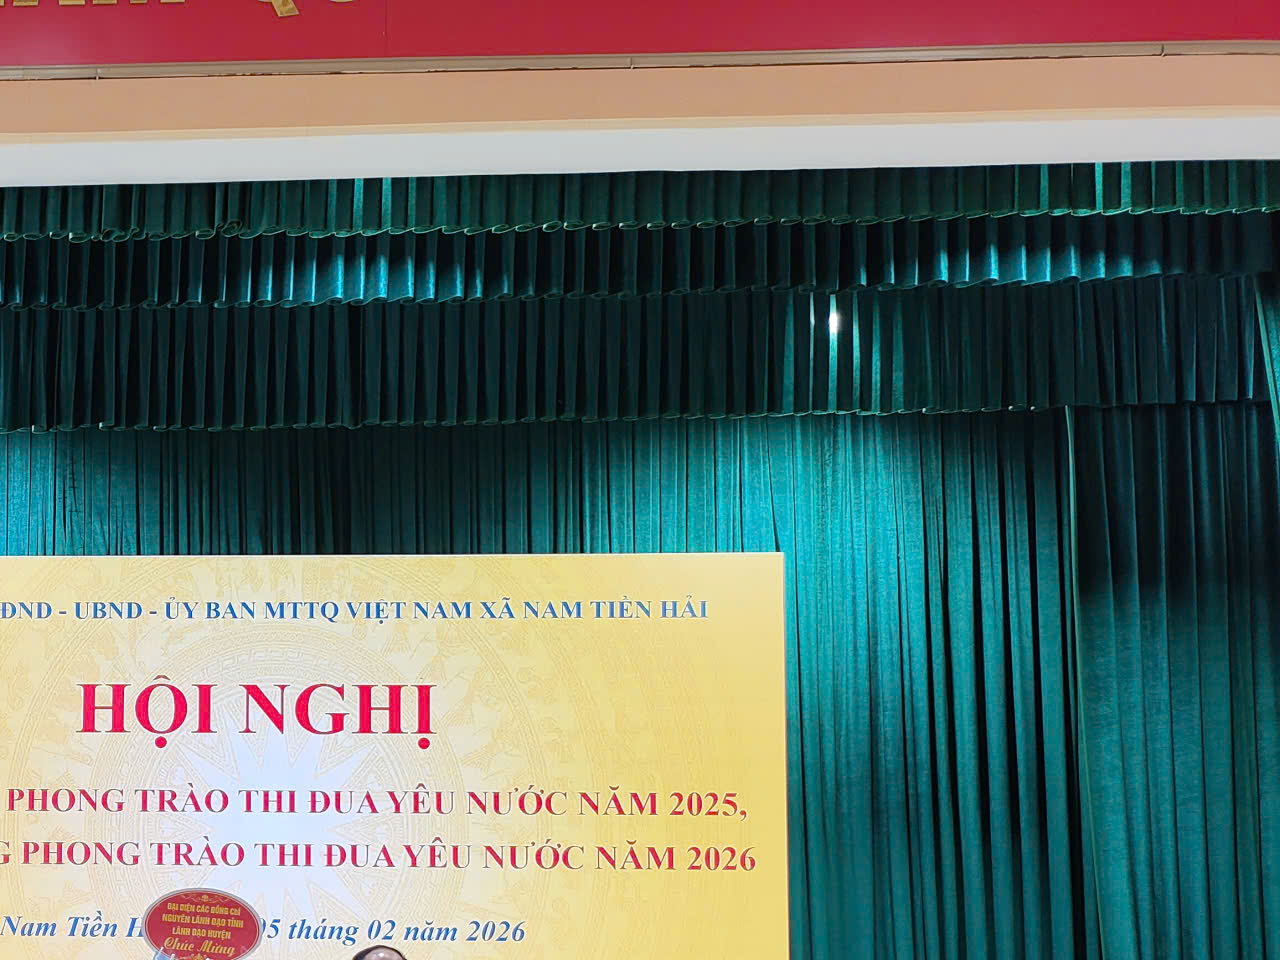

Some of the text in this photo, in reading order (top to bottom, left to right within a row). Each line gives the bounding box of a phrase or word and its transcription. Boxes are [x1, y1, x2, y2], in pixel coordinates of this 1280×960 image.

[74, 600, 144, 620] UBND
[164, 596, 198, 620] ỦY
[205, 601, 256, 620] BAN
[265, 600, 340, 623] MTTQ
[346, 598, 407, 625] VIỆT
[412, 601, 472, 619] NAM
[479, 597, 516, 619] XÃ
[522, 601, 583, 619] NAM
[660, 595, 708, 619] HẢI
[75, 674, 437, 750] HỘI NGHỊ
[7, 788, 124, 812] PHONG
[134, 783, 229, 813] TRÀO
[238, 790, 297, 813] THI
[308, 790, 380, 814] ĐUA
[386, 783, 455, 815] YÊU
[465, 784, 568, 816] NƯỚC
[578, 785, 658, 816] NĂM
[669, 792, 748, 821] 2025,
[22, 841, 140, 866] PHONG
[149, 836, 245, 867] TRÀO
[254, 843, 313, 867] THI
[324, 844, 397, 868] ĐUA
[403, 837, 472, 869] YÊU
[482, 839, 585, 870] NƯỚC
[595, 839, 676, 870] NĂM
[687, 846, 757, 871] 2026
[196, 903, 210, 913] CÁC
[0, 915, 58, 937] Nam
[67, 910, 118, 938] Tiền
[261, 918, 526, 946] 5 tháng 02 năm 2026
[163, 936, 236, 958] Chúc Mừng
